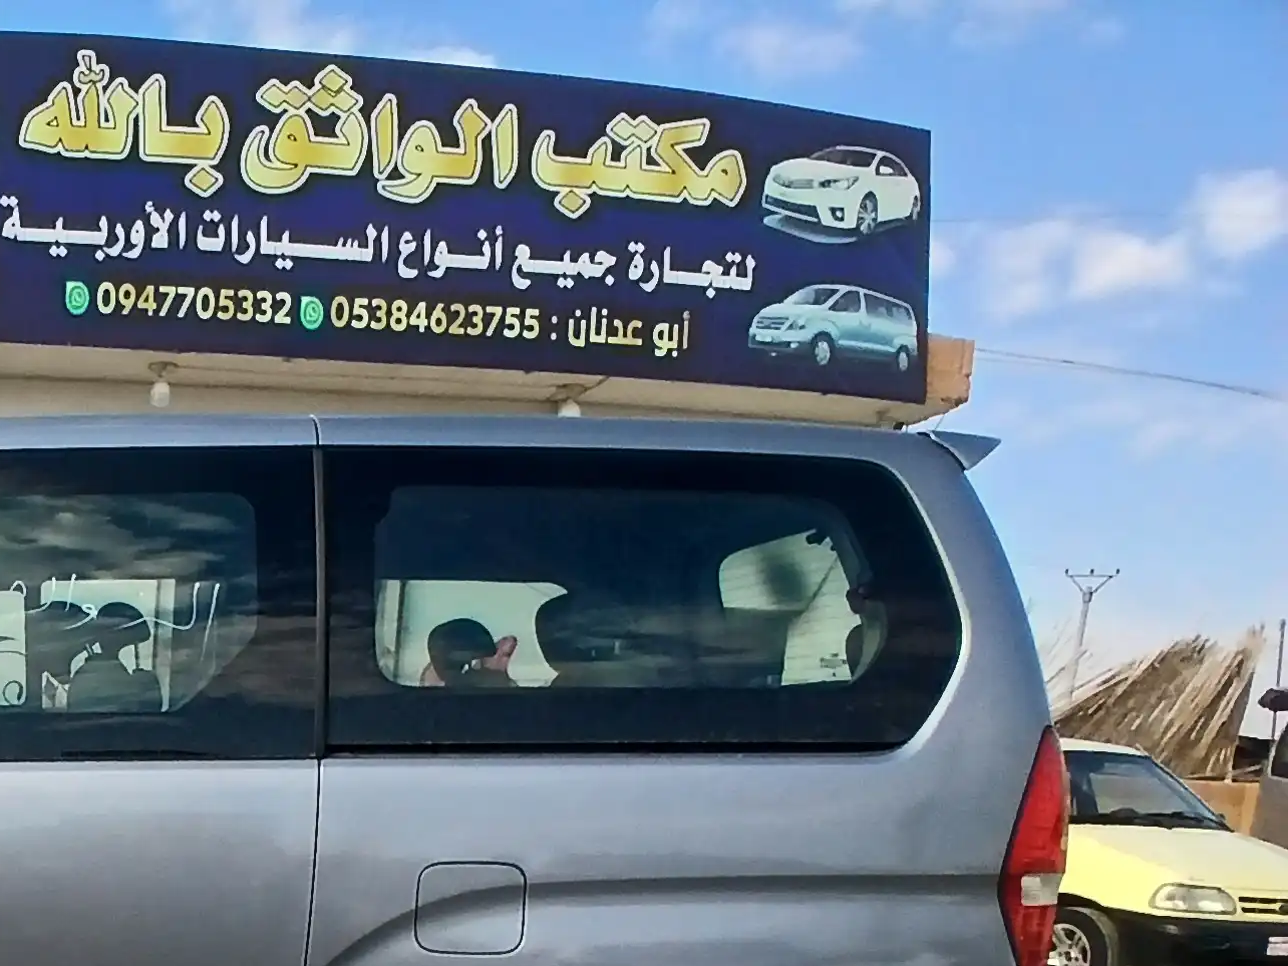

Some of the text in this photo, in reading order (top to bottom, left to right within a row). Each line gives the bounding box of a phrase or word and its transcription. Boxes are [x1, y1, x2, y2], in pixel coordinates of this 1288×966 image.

[18, 50, 748, 218] مكتب الواثق بالله
[0, 195, 756, 299] لتجارة جميع أنواع السيارات الأوربية
[96, 281, 292, 325] 0947705332
[330, 295, 541, 340] 05384623755
[567, 306, 643, 347] عدنان
[651, 311, 690, 357] أبو
